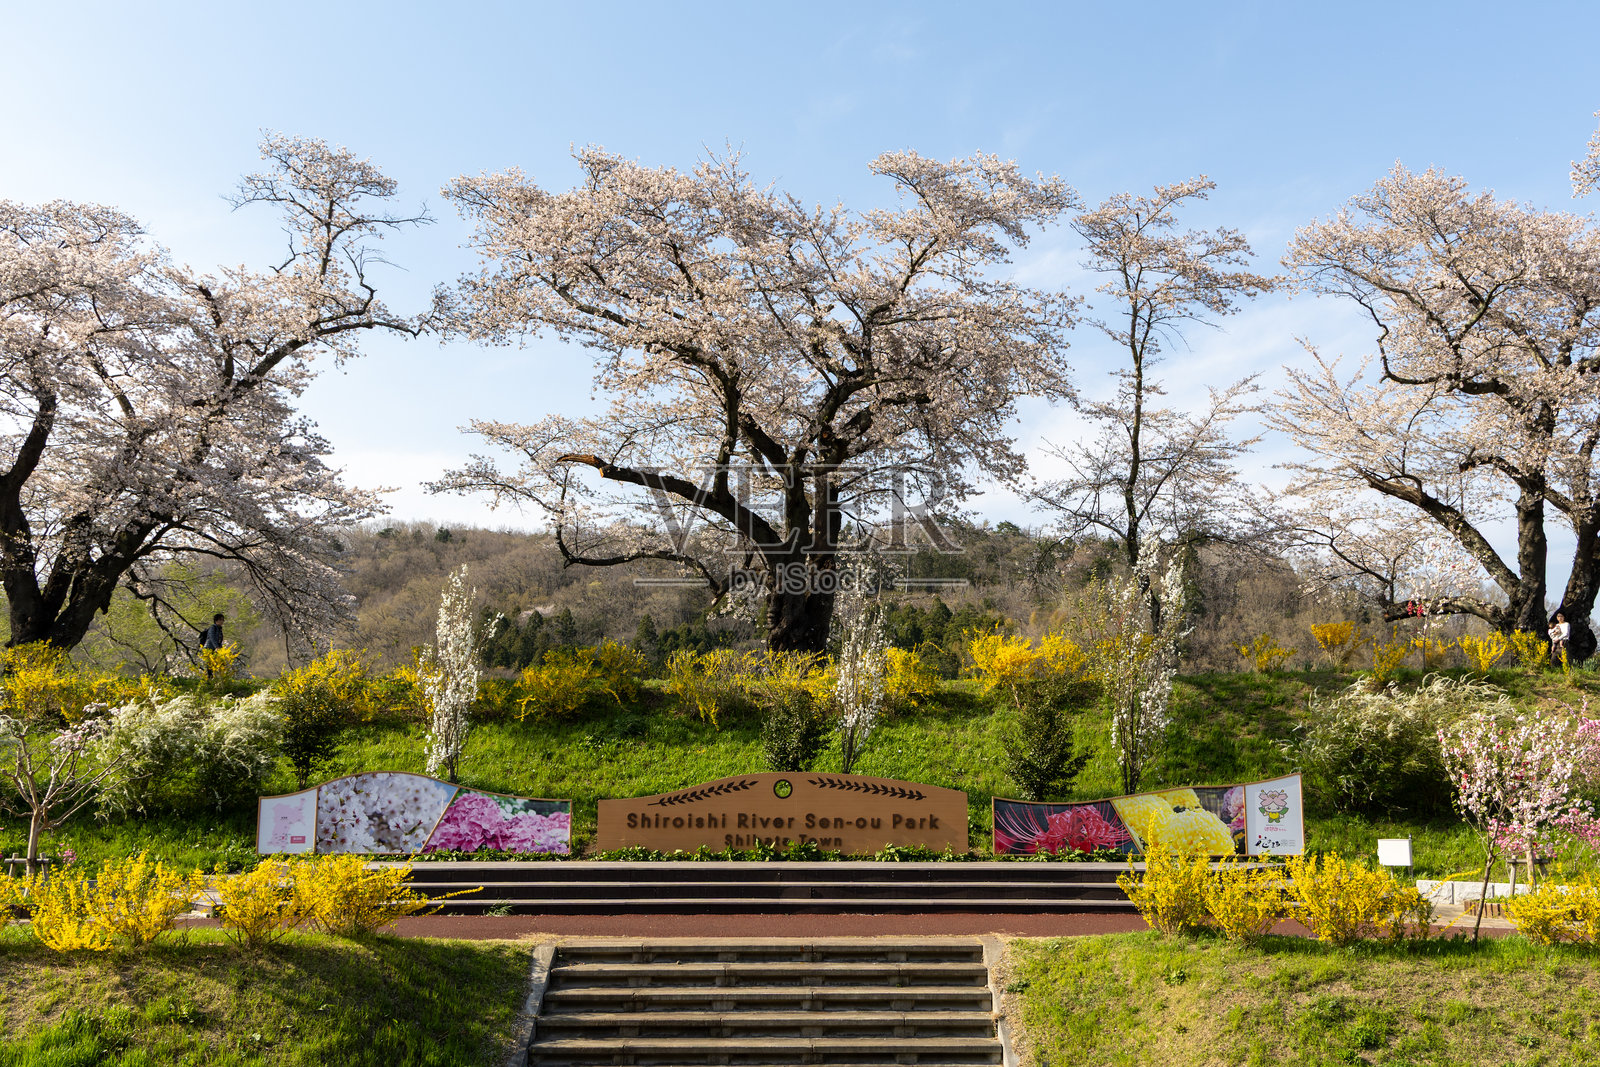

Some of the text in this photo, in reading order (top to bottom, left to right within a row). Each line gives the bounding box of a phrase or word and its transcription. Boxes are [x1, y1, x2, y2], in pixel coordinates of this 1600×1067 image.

[627, 813, 939, 829] Shiroishi River Sen-ou Park
[799, 834, 843, 847] Town
